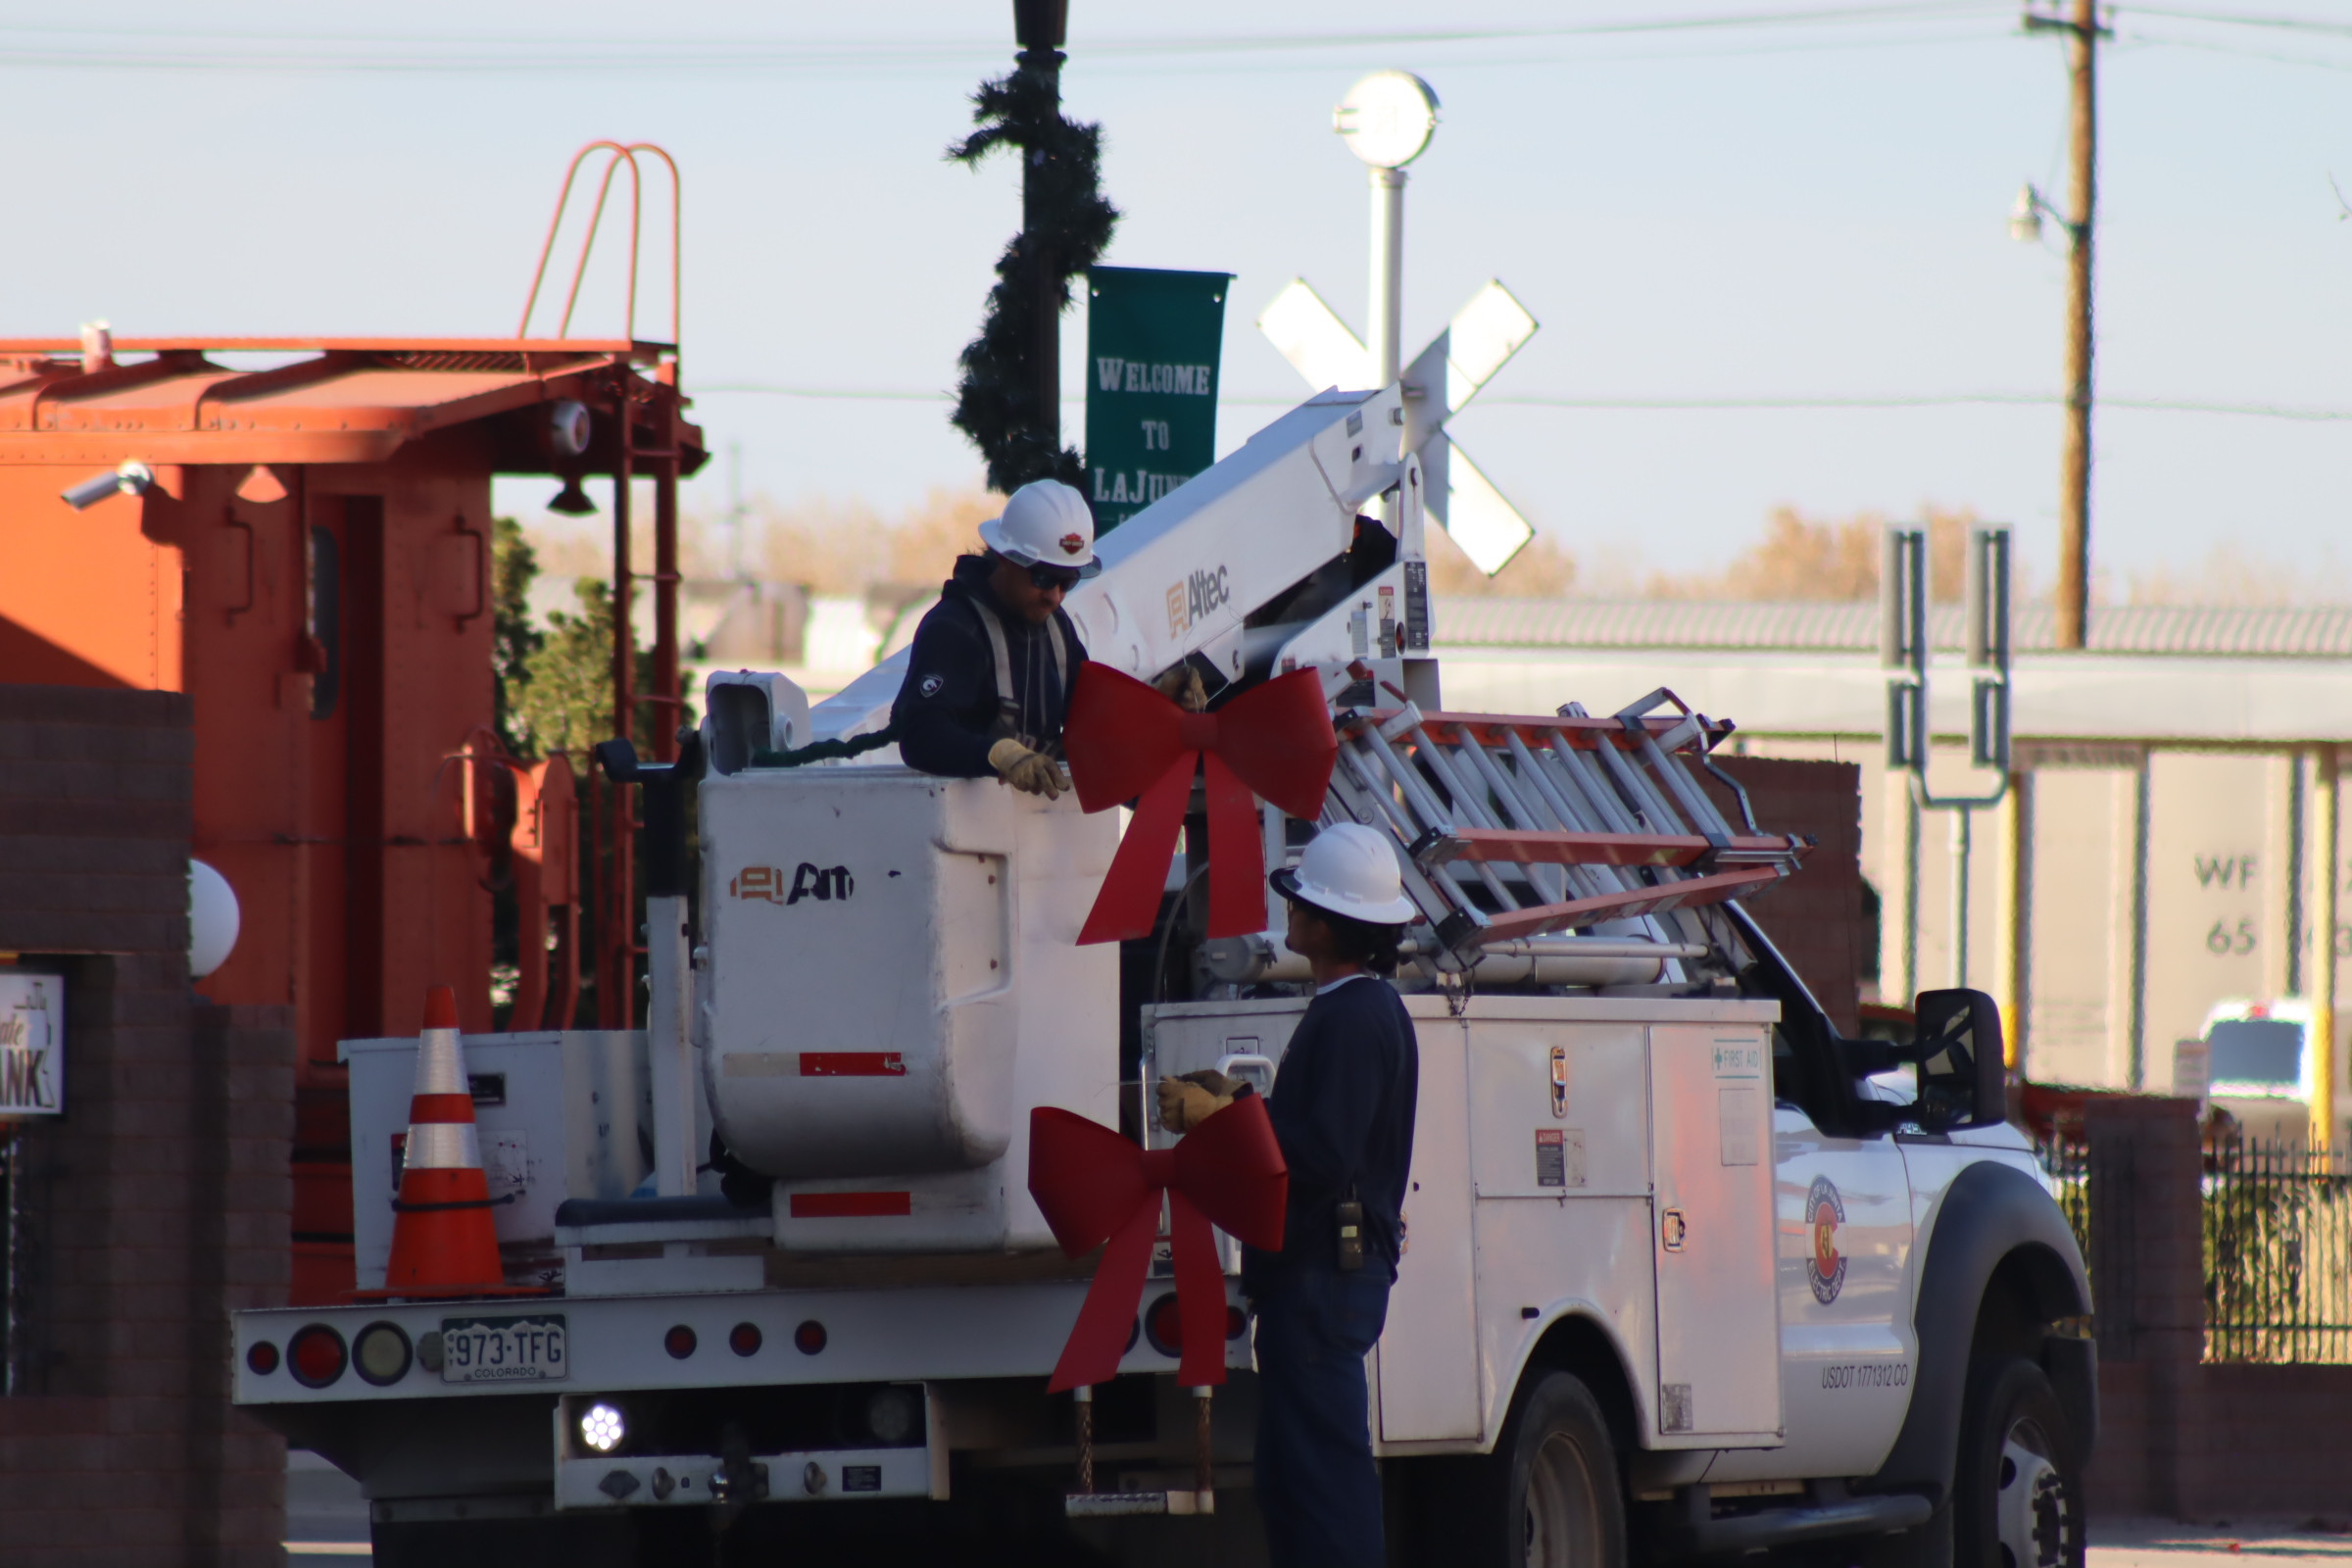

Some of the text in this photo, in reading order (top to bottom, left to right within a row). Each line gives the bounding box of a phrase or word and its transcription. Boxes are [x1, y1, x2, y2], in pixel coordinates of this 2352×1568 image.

[1097, 357, 1211, 396] WELCOME
[1141, 419, 1170, 451] TO
[1188, 564, 1230, 627] Altec
[1724, 1050, 1759, 1068] FIRST AID
[1807, 1195, 1816, 1222] CITY
[1808, 1259, 1833, 1302] ELECTRIC
[474, 1367, 537, 1379] COLORADO
[1822, 1363, 1909, 1389] USDOT 1771312 CO
